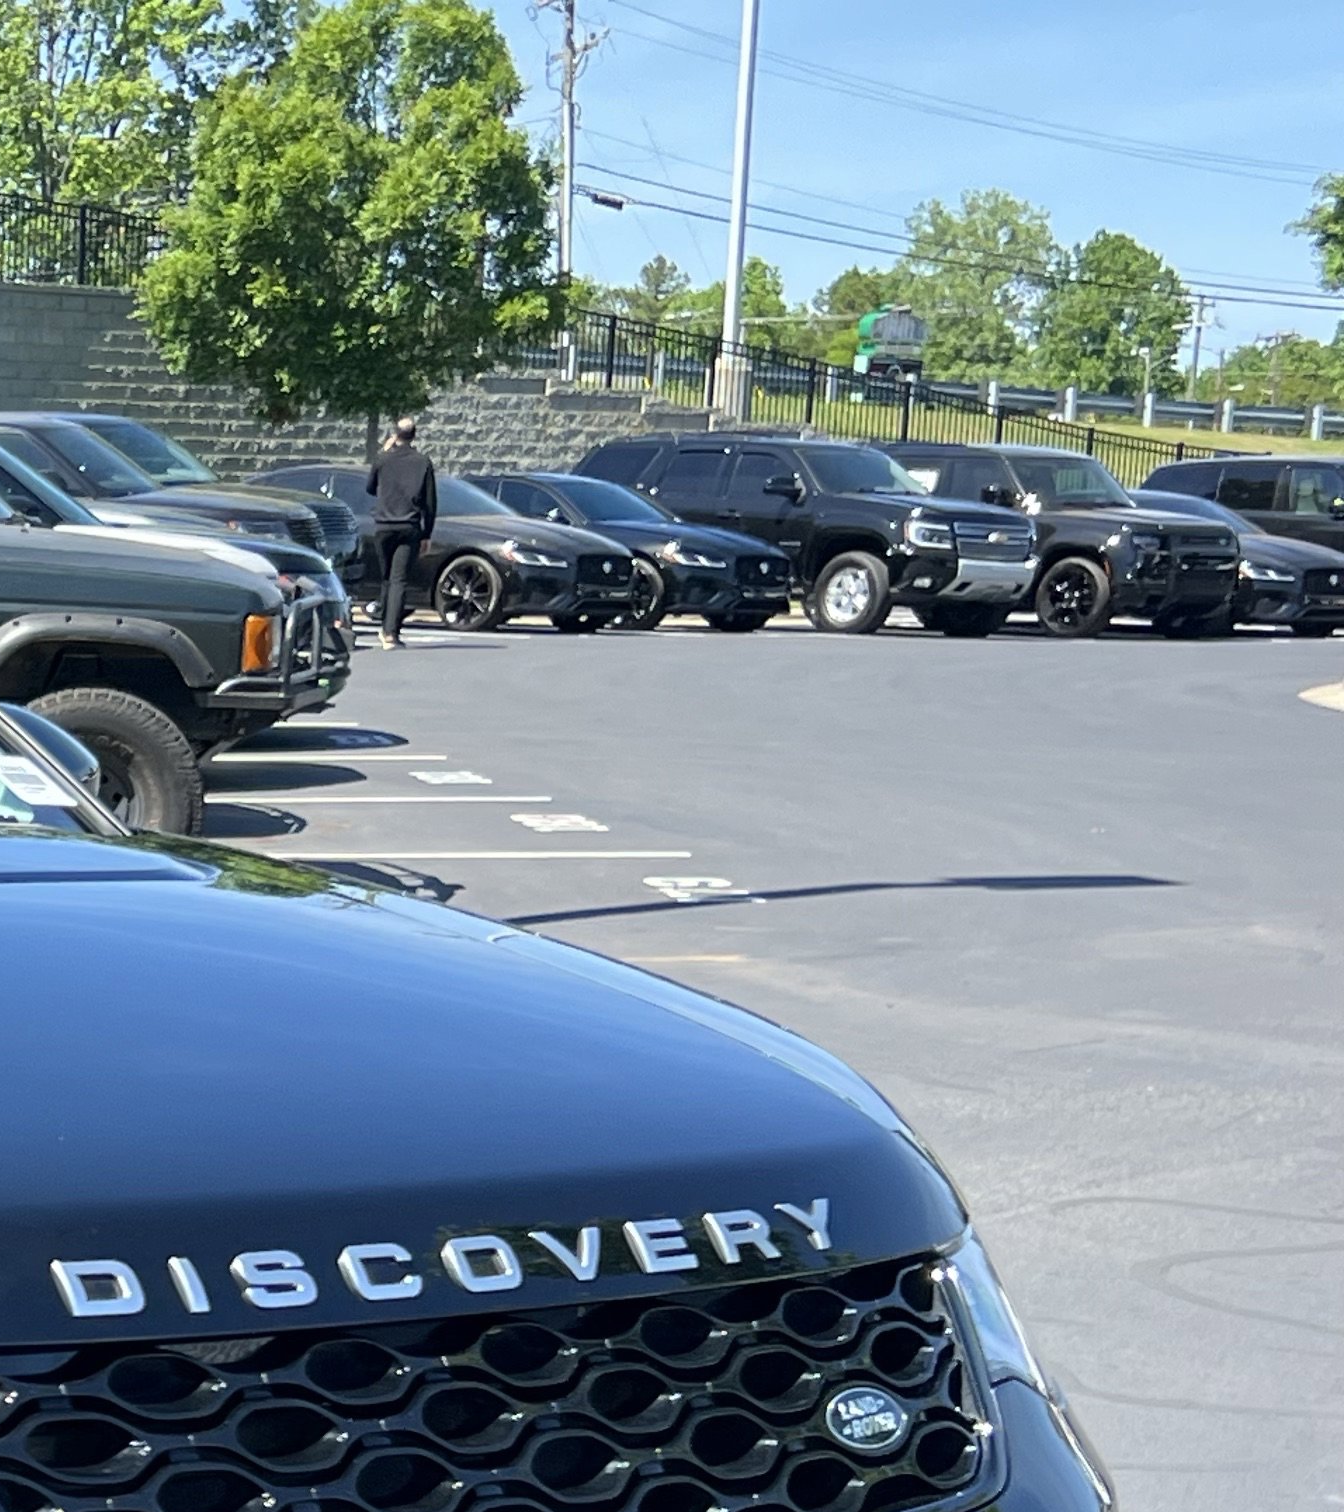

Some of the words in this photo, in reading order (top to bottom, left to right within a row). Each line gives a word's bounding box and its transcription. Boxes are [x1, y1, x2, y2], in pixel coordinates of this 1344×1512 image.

[50, 1198, 830, 1317] DISCOVERY
[838, 1396, 879, 1420] LAND
[852, 1411, 897, 1438] ROVER
